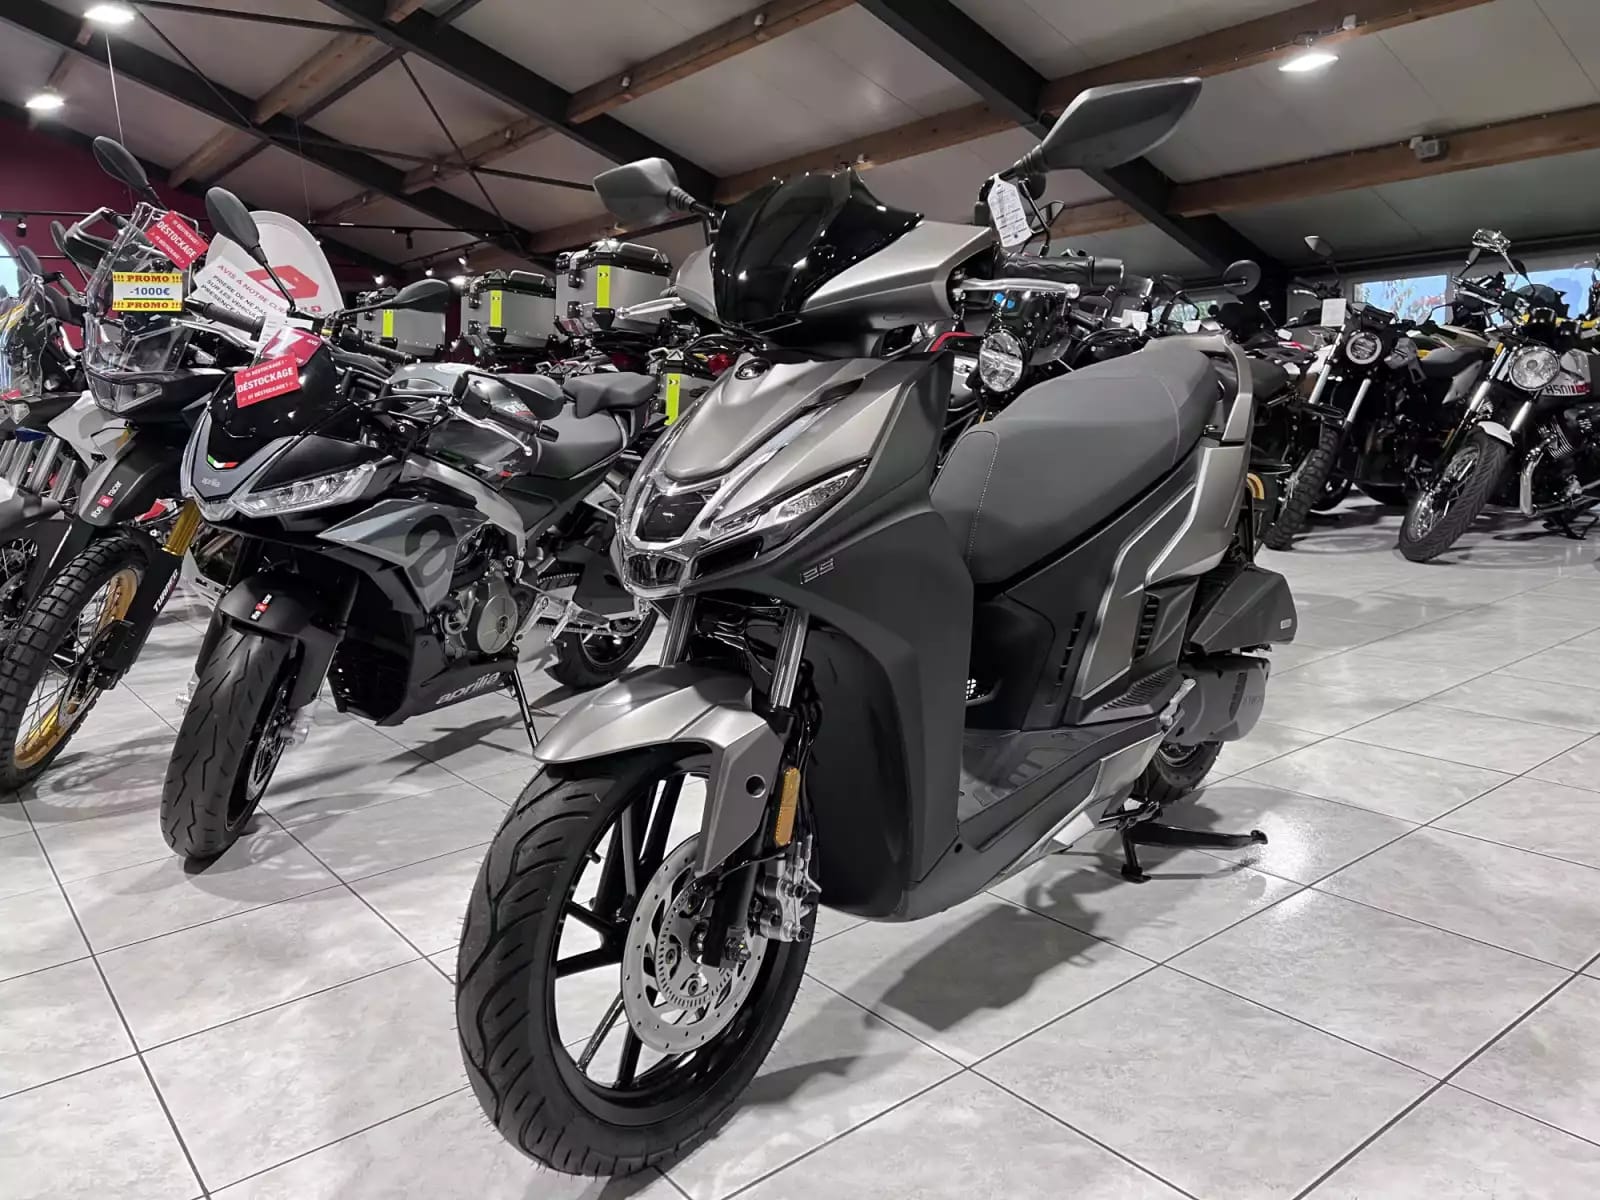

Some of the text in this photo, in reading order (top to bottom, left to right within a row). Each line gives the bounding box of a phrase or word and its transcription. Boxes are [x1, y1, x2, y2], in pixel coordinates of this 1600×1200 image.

[156, 220, 197, 258] DÉSTOCKAGE
[130, 287, 170, 296] -1000€
[206, 280, 221, 292] SUR
[220, 290, 232, 300] LES
[217, 264, 236, 280] AVIS
[242, 284, 267, 302] NOTRE
[235, 291, 245, 301] DE
[246, 299, 255, 308] NE
[237, 367, 294, 393] DÉSTOCKAGE
[435, 672, 501, 705] aprilia
